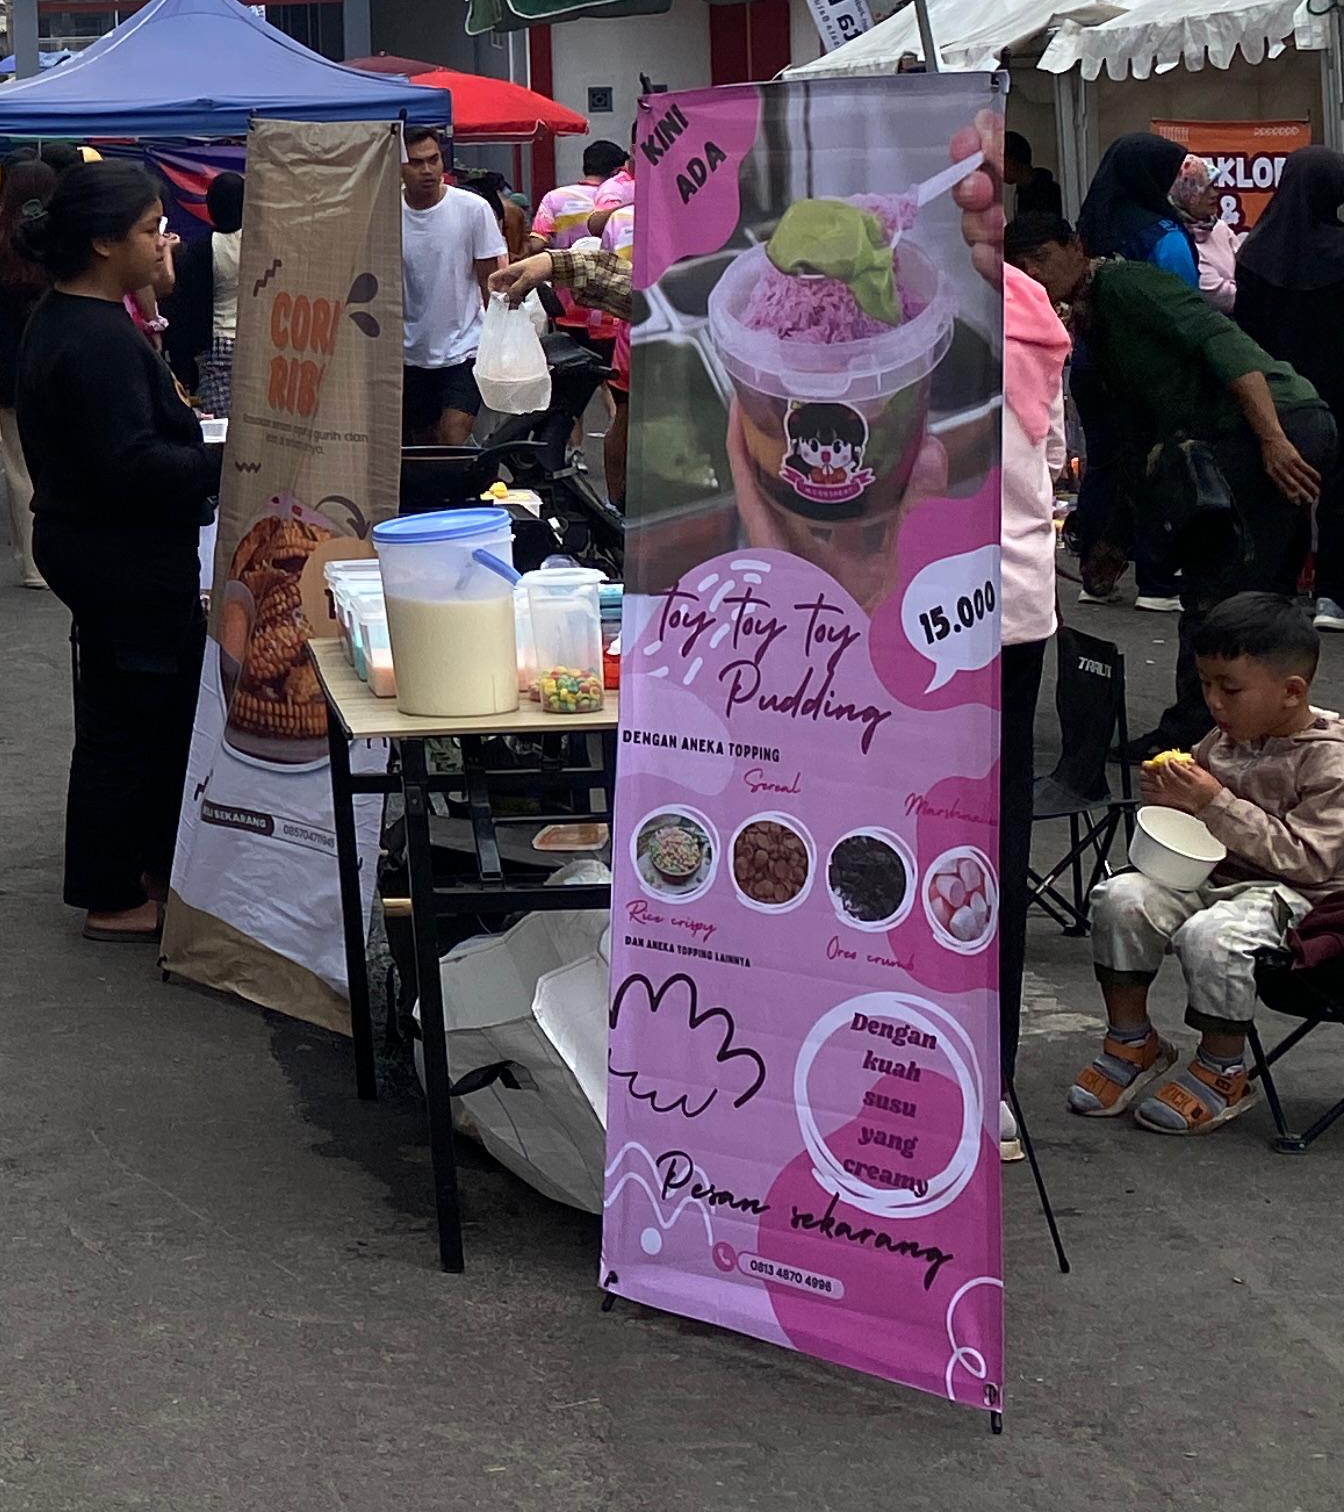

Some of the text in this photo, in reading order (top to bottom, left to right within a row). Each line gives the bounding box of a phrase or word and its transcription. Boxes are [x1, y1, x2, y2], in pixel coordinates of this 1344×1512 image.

[640, 103, 689, 166] KINI
[676, 141, 727, 205] ADA
[1219, 195, 1241, 225] &
[344, 430, 369, 443] dan
[919, 580, 996, 645] 15.000
[718, 659, 892, 755] Pudding
[622, 730, 781, 763] DENGAN ANEKA TOPPING
[743, 768, 802, 794] Sereal
[214, 809, 268, 829] SEKARANG
[670, 916, 718, 943] crispy
[624, 935, 752, 968] DAN ANEKA TOPPING LAINNYA
[850, 1012, 938, 1050] Dengan
[862, 1050, 922, 1083] kuah
[862, 1090, 918, 1119] susu
[857, 1126, 919, 1159] yang
[843, 1157, 930, 1199] creamy
[655, 1150, 954, 1291] Pesan sekarang
[750, 1259, 774, 1276] 0813
[775, 1267, 803, 1284] 4870
